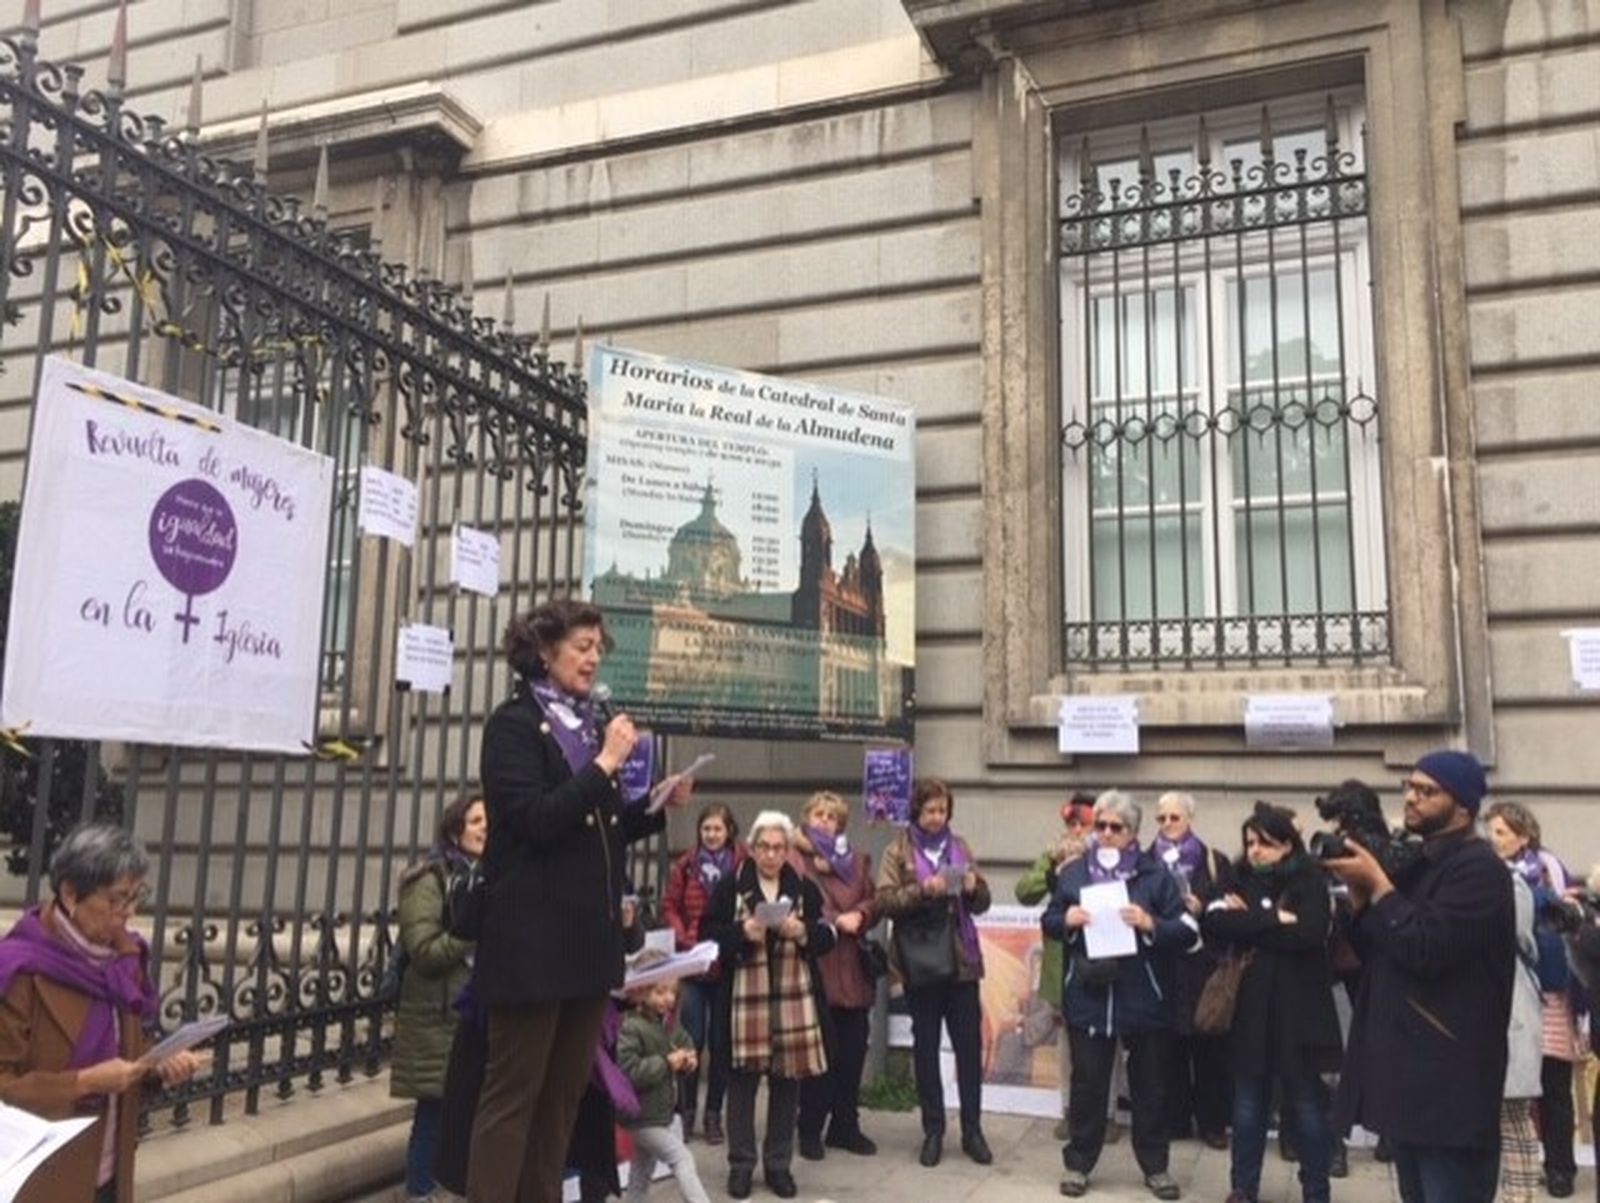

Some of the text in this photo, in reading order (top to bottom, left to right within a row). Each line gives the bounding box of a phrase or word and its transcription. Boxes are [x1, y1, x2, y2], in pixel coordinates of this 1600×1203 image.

[608, 358, 907, 427] Horarios de la Catedral de Santa
[635, 429, 696, 446] APERTURA
[697, 437, 719, 449] DEL
[688, 402, 706, 418] la
[708, 404, 753, 427] Real
[754, 414, 774, 429] de
[776, 417, 792, 433] la
[793, 418, 895, 451] Almudena
[86, 419, 181, 468] Revuelta
[197, 446, 222, 480] de
[229, 462, 297, 521] mujeres
[157, 511, 235, 551] igualdad
[80, 579, 283, 665] en la Iglesia
